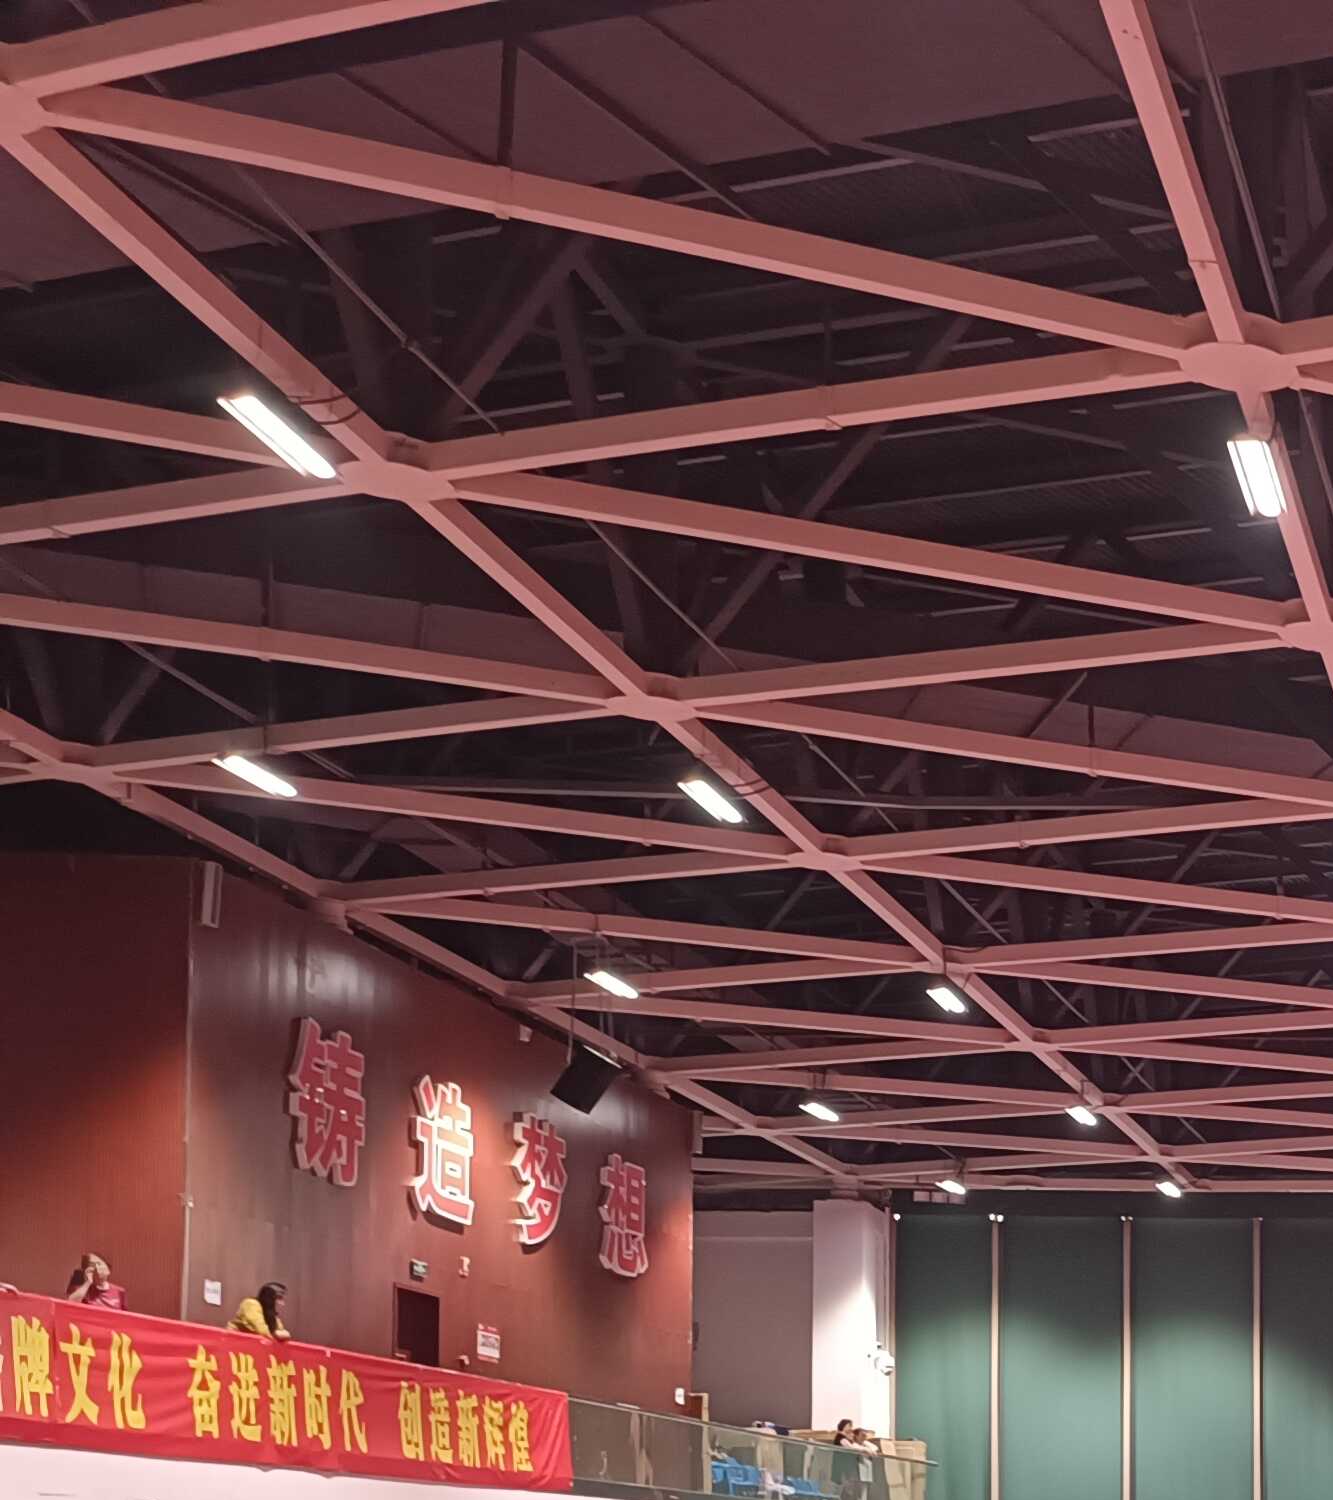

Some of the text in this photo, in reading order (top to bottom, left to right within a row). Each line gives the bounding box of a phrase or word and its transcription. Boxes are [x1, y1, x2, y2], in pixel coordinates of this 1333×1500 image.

[288, 1015, 648, 1278] 铸造梦想
[0, 1313, 535, 1473] 牌文化 奋进新时代 创造新辉煌
